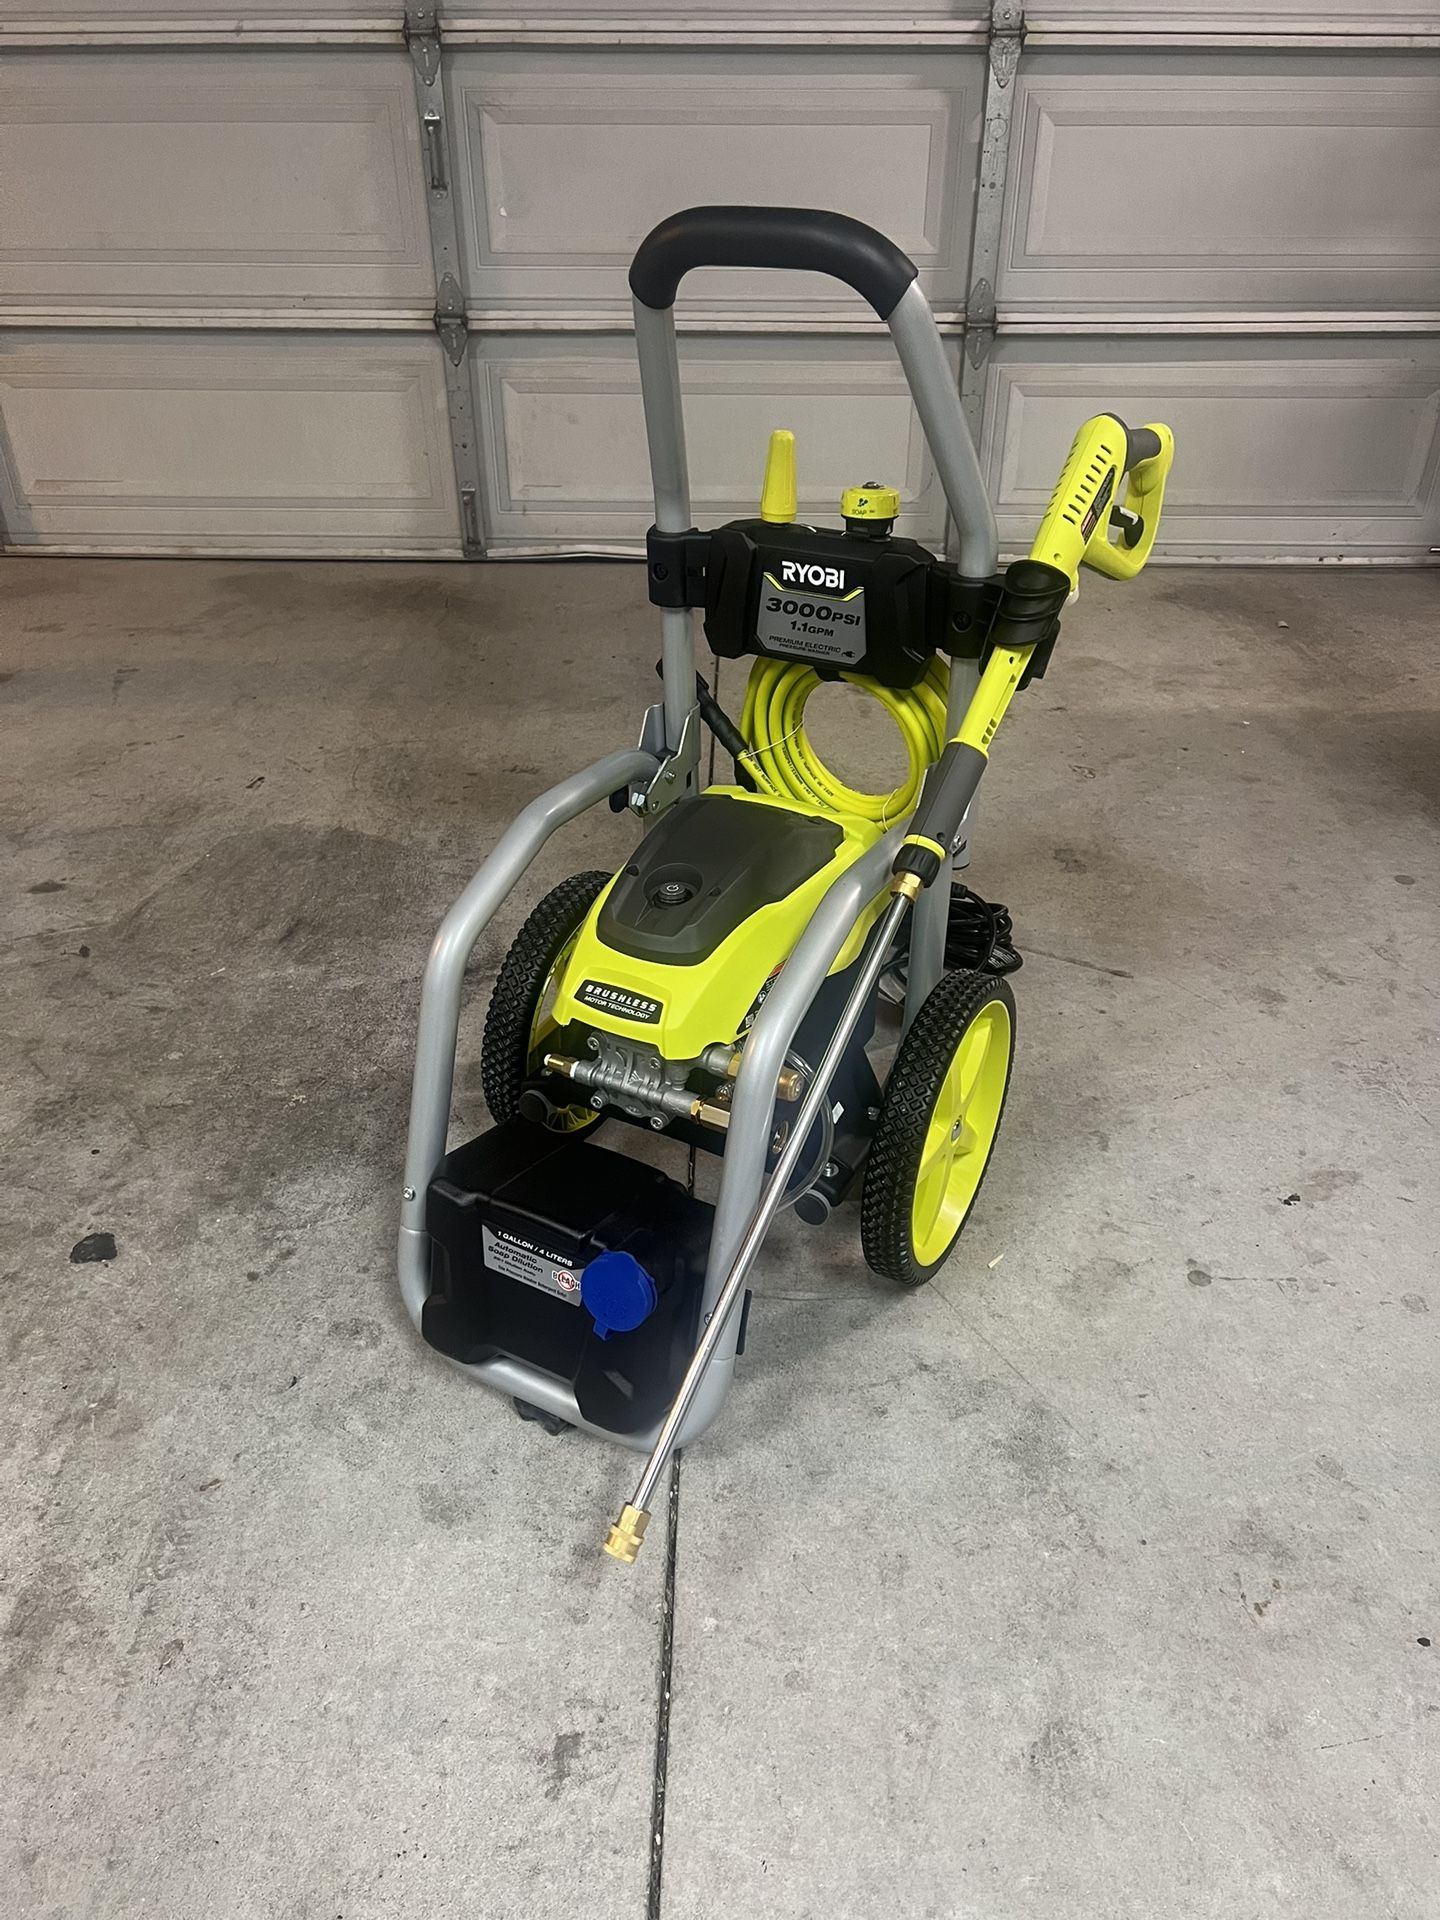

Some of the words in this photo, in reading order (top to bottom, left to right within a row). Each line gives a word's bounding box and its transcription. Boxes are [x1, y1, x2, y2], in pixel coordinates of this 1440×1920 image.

[782, 561, 845, 589] RYOBI
[766, 597, 860, 625] 3000PSI
[791, 620, 834, 636] 1.1GPM
[769, 635, 803, 646] PREMIUM
[805, 641, 841, 653] ELECTRIC
[584, 996, 607, 1006] MOTOR
[607, 1002, 650, 1020] TECHNOLOGY
[585, 985, 657, 1011] BRUSHLESS
[488, 1246, 509, 1259] Soap
[512, 1255, 543, 1273] Dilution
[495, 1242, 537, 1263] Automatic
[503, 1233, 533, 1250] GALLON
[546, 1251, 573, 1266] LITERS
